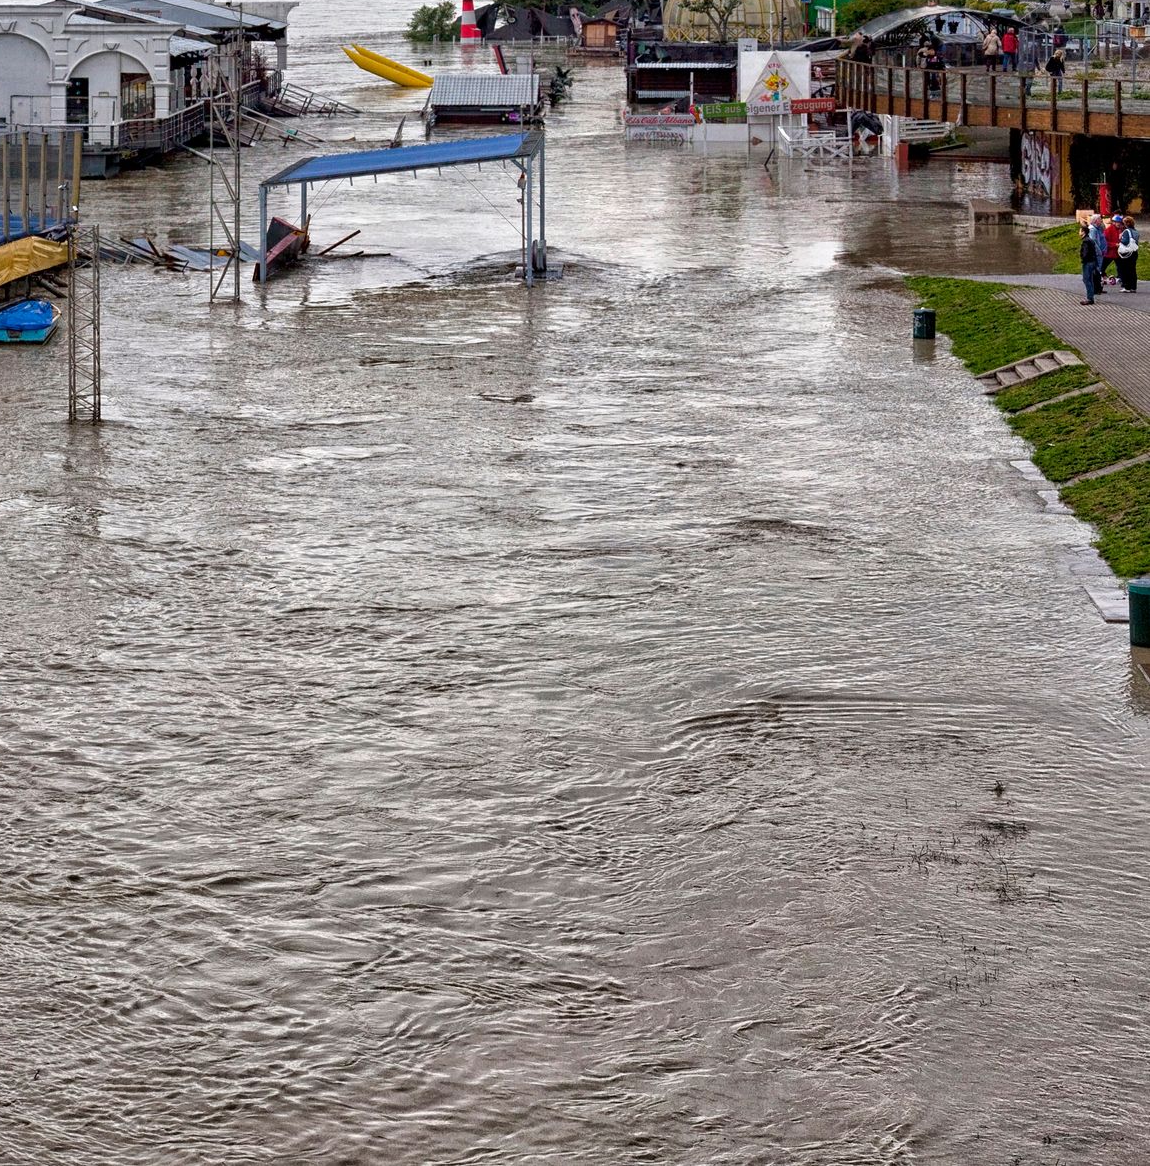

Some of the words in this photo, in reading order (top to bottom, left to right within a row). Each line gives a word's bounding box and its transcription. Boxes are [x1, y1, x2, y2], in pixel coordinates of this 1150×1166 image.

[705, 105, 722, 114] EIS
[724, 105, 741, 114] aus
[745, 103, 781, 114] eigener
[783, 101, 833, 112] Ezeugung
